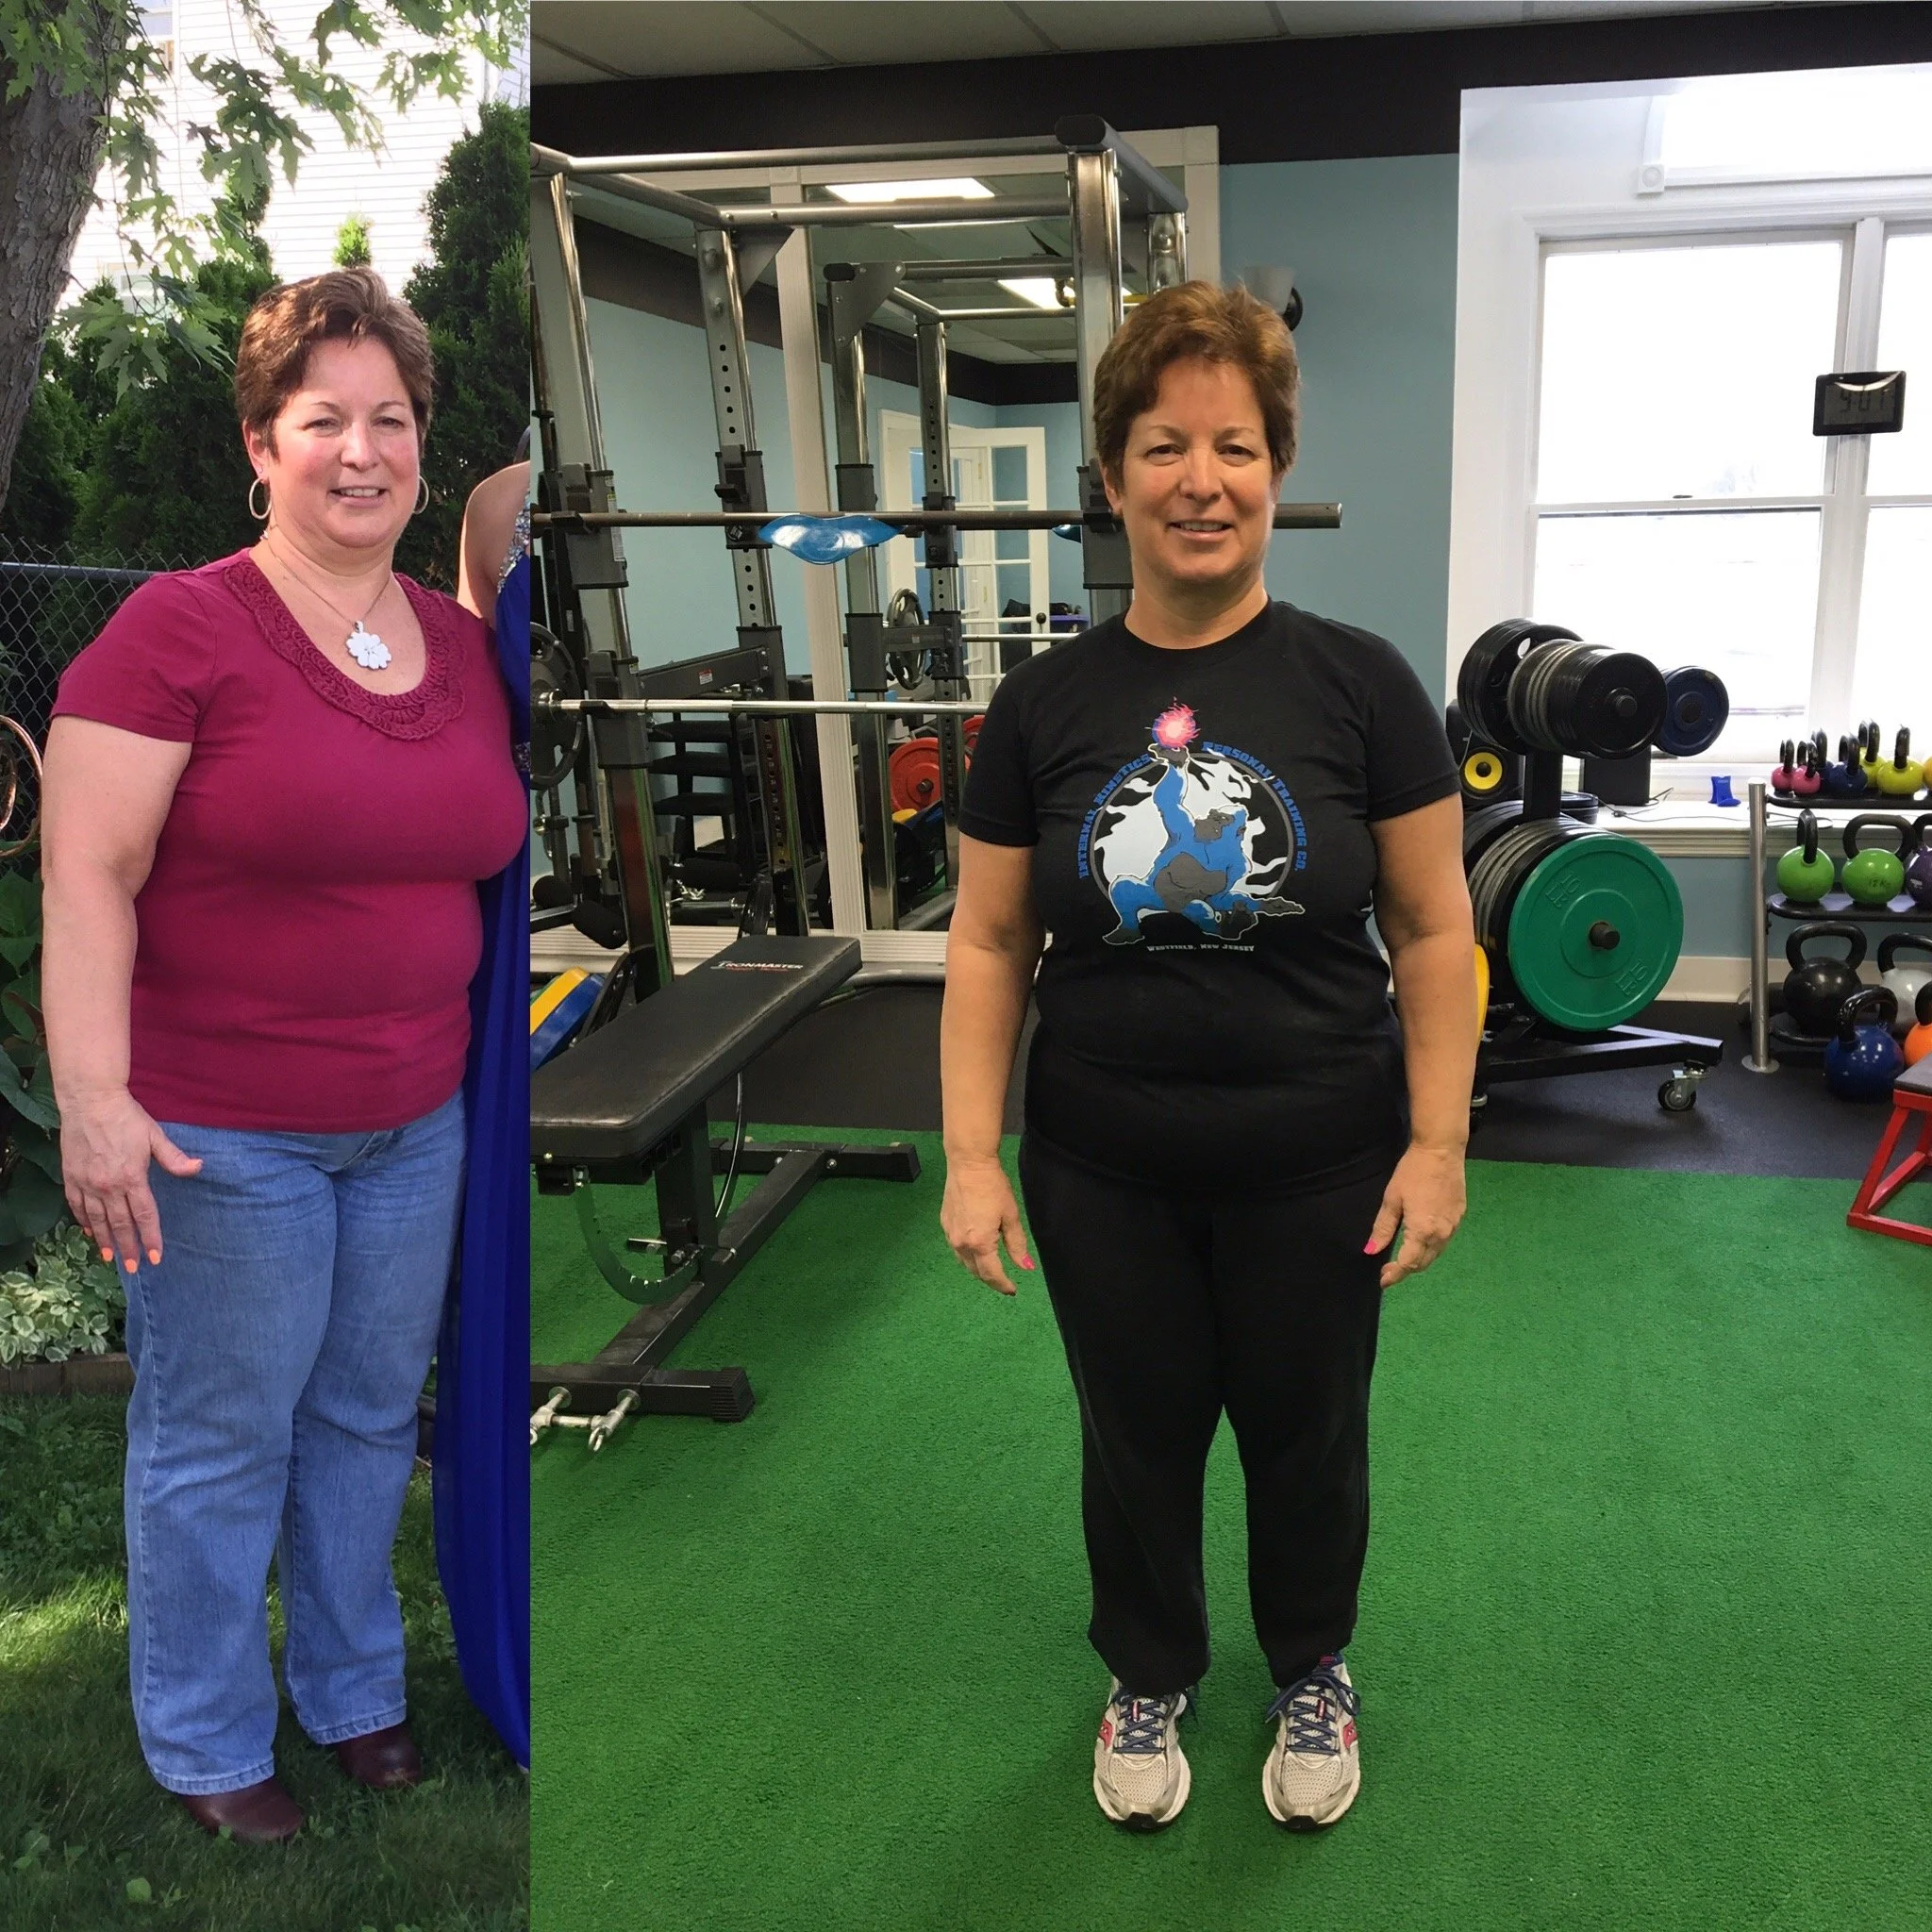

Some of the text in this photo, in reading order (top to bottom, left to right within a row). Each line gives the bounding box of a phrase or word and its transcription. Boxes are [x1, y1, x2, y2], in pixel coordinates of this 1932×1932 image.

[1202, 741, 1273, 780] PERSONAL
[1272, 778, 1307, 846] TRAINING
[1223, 943, 1255, 952] JERSEY
